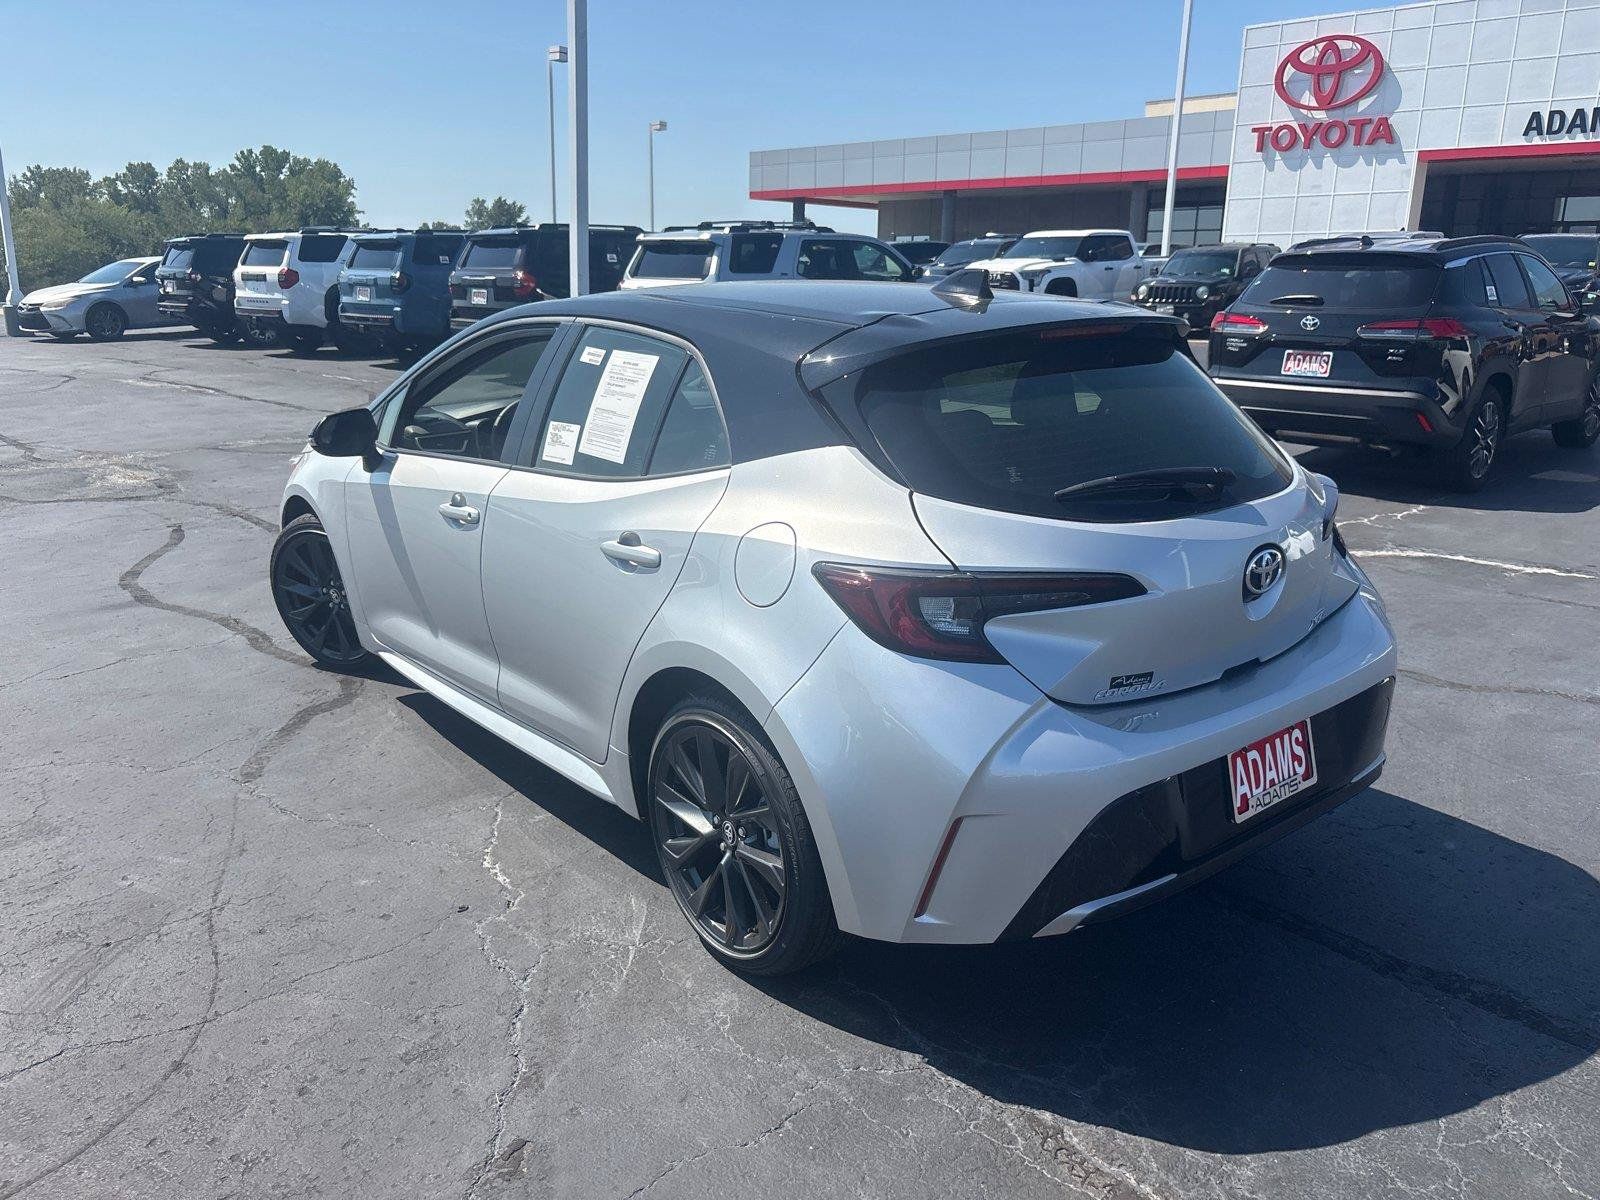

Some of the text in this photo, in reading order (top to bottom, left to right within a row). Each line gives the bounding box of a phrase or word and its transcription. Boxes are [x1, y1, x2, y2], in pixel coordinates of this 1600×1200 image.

[1252, 116, 1394, 152] TOYOTA
[1285, 354, 1328, 373] ADAMS
[1236, 728, 1306, 807] ADAMS
[1254, 777, 1299, 811] ADAMS
